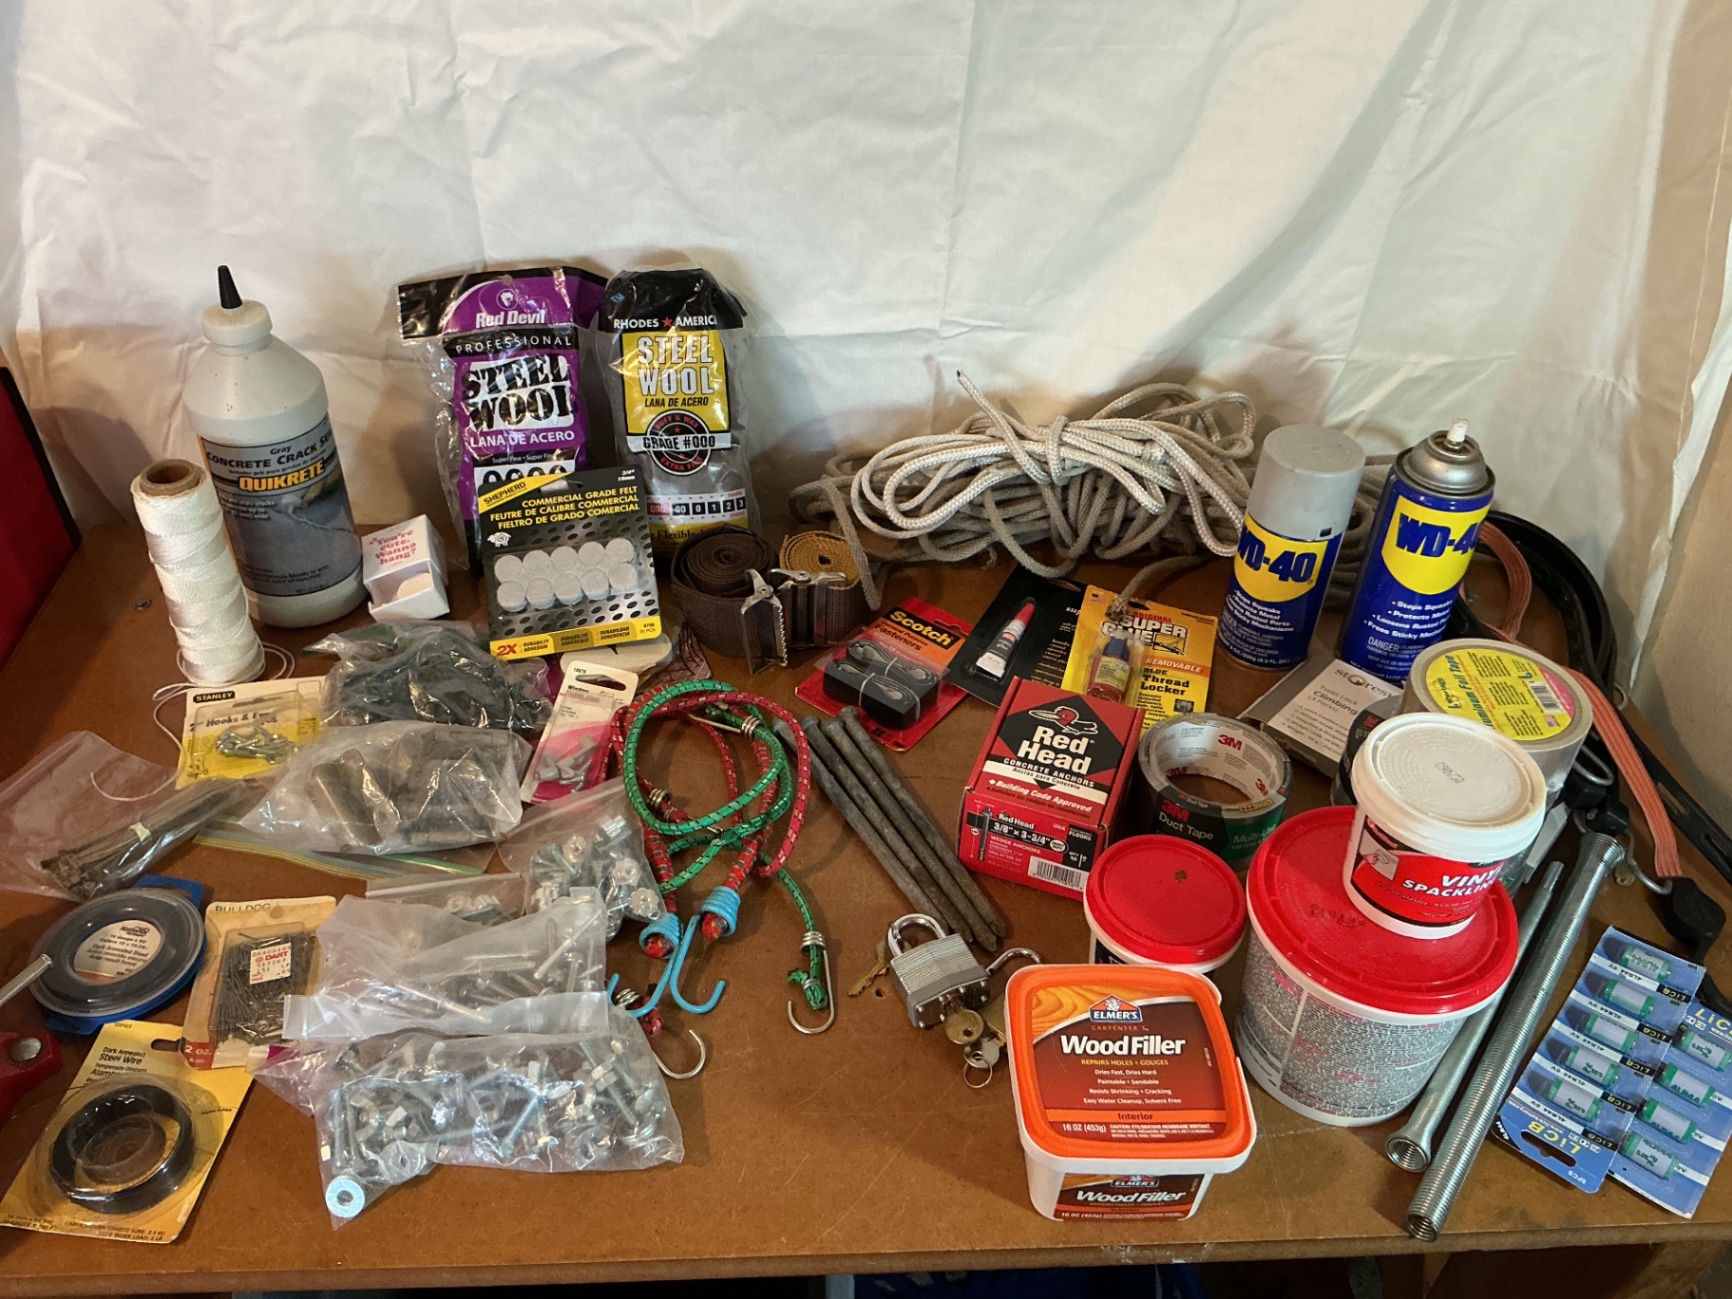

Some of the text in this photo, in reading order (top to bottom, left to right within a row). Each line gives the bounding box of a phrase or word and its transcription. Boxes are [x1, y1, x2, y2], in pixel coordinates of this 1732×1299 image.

[476, 310, 546, 328] Red Devil
[613, 317, 659, 329] RHODES
[455, 336, 572, 354] PROFESSIONAL
[637, 335, 714, 365] STEEL
[638, 366, 714, 396] WOOL
[644, 396, 709, 408] LANA DE ACERO
[683, 415, 700, 430] WAX
[470, 430, 575, 448] LANA DE ACERO
[643, 435, 716, 450] GRADE #000
[206, 451, 272, 469] CONCRETE
[276, 444, 318, 465] CRACK
[269, 445, 292, 455] Gray
[660, 457, 685, 471] EXTRA
[238, 457, 325, 492] QUIKRETE
[483, 481, 527, 506] SHEPHERD
[521, 486, 638, 508] COMMERCIAL GRADE FELT
[490, 510, 522, 522] FEUTRE
[525, 508, 537, 516] DE
[539, 503, 575, 514] CALIBRE
[577, 495, 639, 510] COMMERCIAL
[711, 504, 717, 512] 1
[726, 501, 732, 510] 2
[738, 500, 744, 508] 3
[498, 517, 533, 530] FIELTRO
[536, 515, 548, 525] DE
[550, 510, 585, 523] GRADO
[587, 503, 640, 517] COMERCIAL
[1395, 512, 1480, 558] WD-4
[1238, 525, 1318, 584] WD-40
[1397, 601, 1422, 610] Stops
[1259, 611, 1281, 620] Metal
[1376, 614, 1441, 630] Loosens Rusted
[1393, 610, 1430, 620] Protects
[890, 610, 954, 646] Scotch
[1121, 614, 1188, 639] SUPER
[1368, 621, 1418, 640] Frees Sticky
[874, 624, 922, 651] Fasteners
[496, 642, 518, 656] 2X
[1146, 658, 1204, 675] REMOVABLE
[1445, 655, 1460, 673] Tape
[1141, 682, 1187, 697] Locker
[1142, 675, 1190, 689] Thread
[195, 692, 233, 702] STANLEY
[1313, 691, 1359, 716] Climbing
[206, 716, 239, 728] Hooks
[1032, 725, 1090, 755] Red
[1218, 734, 1243, 751] 3M
[1017, 740, 1092, 775] Head
[1003, 757, 1095, 788] CONCRETE ANCHORS
[1012, 767, 1081, 790] Anclas para Concreto
[996, 780, 1030, 796] Building
[1031, 789, 1052, 801] Code
[1053, 796, 1093, 813] Approved
[1161, 799, 1190, 822] 3M
[998, 813, 1035, 830] Red Head
[1159, 811, 1214, 841] Duct Tape
[990, 835, 1011, 846] WEDGE
[994, 822, 1051, 845] 3/8" 3-3/4"
[1068, 830, 1092, 842] FLOORS
[264, 951, 289, 961] DART
[1661, 986, 1687, 1002] LiCB
[1092, 1010, 1139, 1020] ELMER'S
[1642, 1026, 1668, 1042] LiCB
[102, 1045, 146, 1058] Dark Annealed
[185, 1045, 193, 1053] 2
[99, 1052, 143, 1066] Steel Wire
[1111, 1069, 1125, 1077] Fast,
[1625, 1059, 1652, 1076] LiCB
[1563, 1073, 1587, 1087] 4LR44
[1110, 1088, 1140, 1096] Shrinking
[1144, 1088, 1172, 1096] Cracking
[1083, 1097, 1097, 1105] Easy
[1117, 1097, 1144, 1105] Cleanup,
[1606, 1095, 1632, 1111] LiCB
[1117, 1112, 1154, 1121] Interior
[1543, 1108, 1567, 1123] 4LR44
[1062, 1123, 1107, 1133] 16 OZ (453g)
[1528, 1120, 1582, 1155] LiCB
[1586, 1132, 1614, 1149] LiCB
[1567, 1169, 1587, 1185] 5PCS
